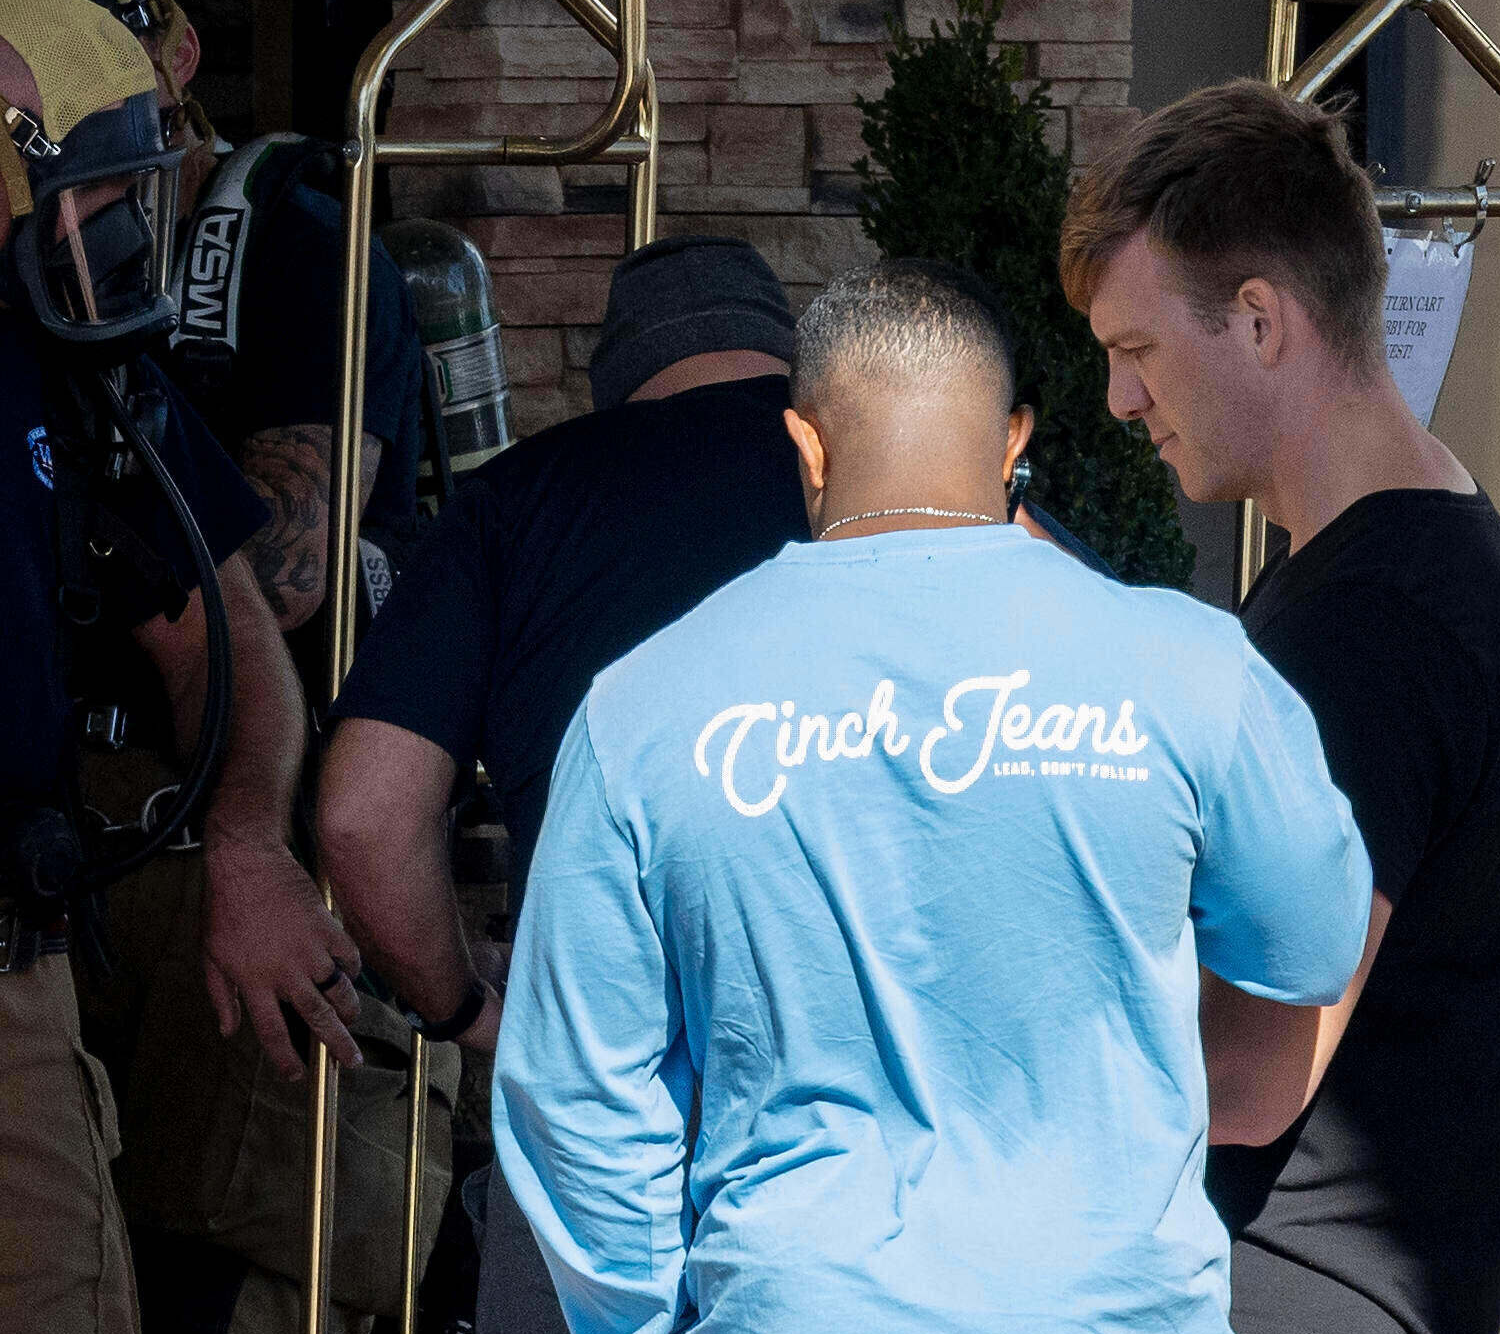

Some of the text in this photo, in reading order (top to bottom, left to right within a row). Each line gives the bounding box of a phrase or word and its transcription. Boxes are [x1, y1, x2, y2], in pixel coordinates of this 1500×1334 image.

[185, 212, 239, 330] MSA
[1384, 295, 1445, 312] TURN CART
[1404, 321, 1427, 336] FOR
[694, 669, 1149, 817] Cinch Jeans
[993, 760, 1149, 782] LEAD, DON'T FOLLOW
